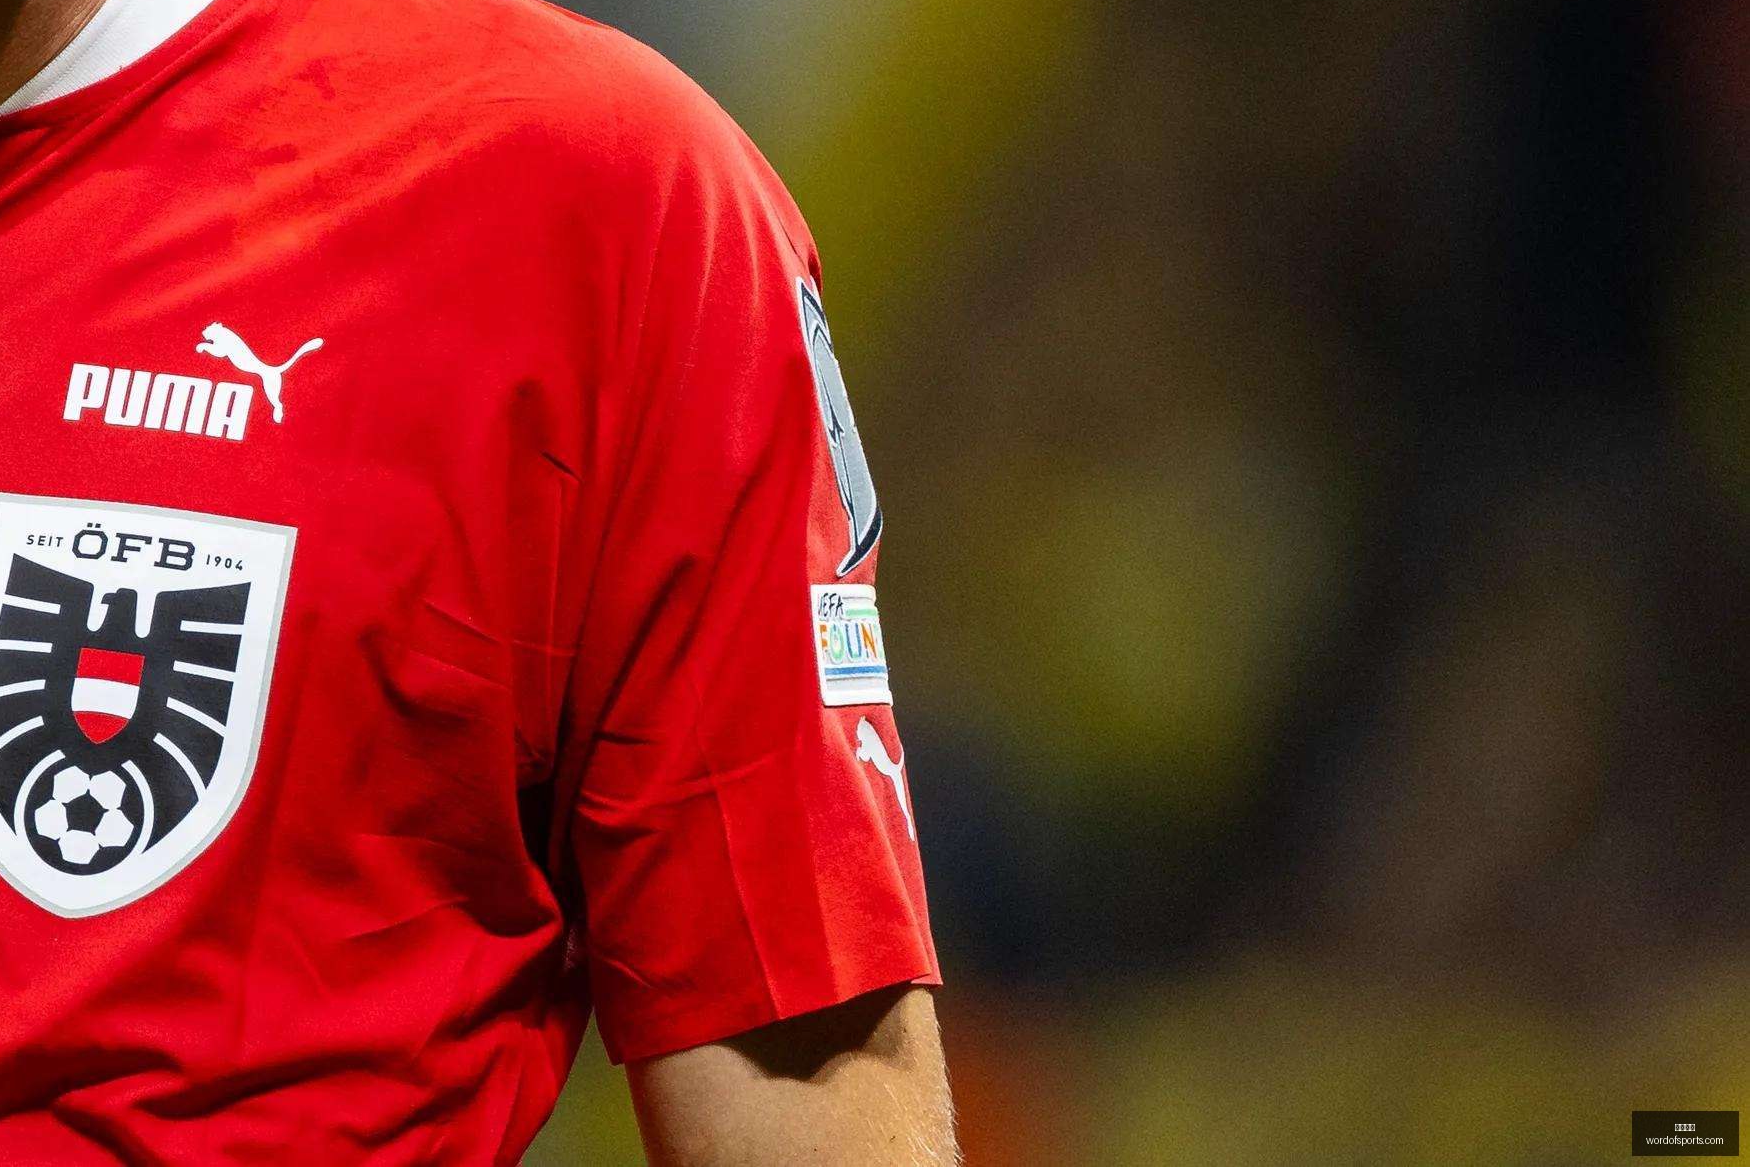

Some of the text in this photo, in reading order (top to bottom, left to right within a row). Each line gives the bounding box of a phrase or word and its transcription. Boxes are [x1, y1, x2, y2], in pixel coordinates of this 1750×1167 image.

[62, 362, 254, 441] PUMA
[26, 522, 244, 571] SEIT ÖFB 1904
